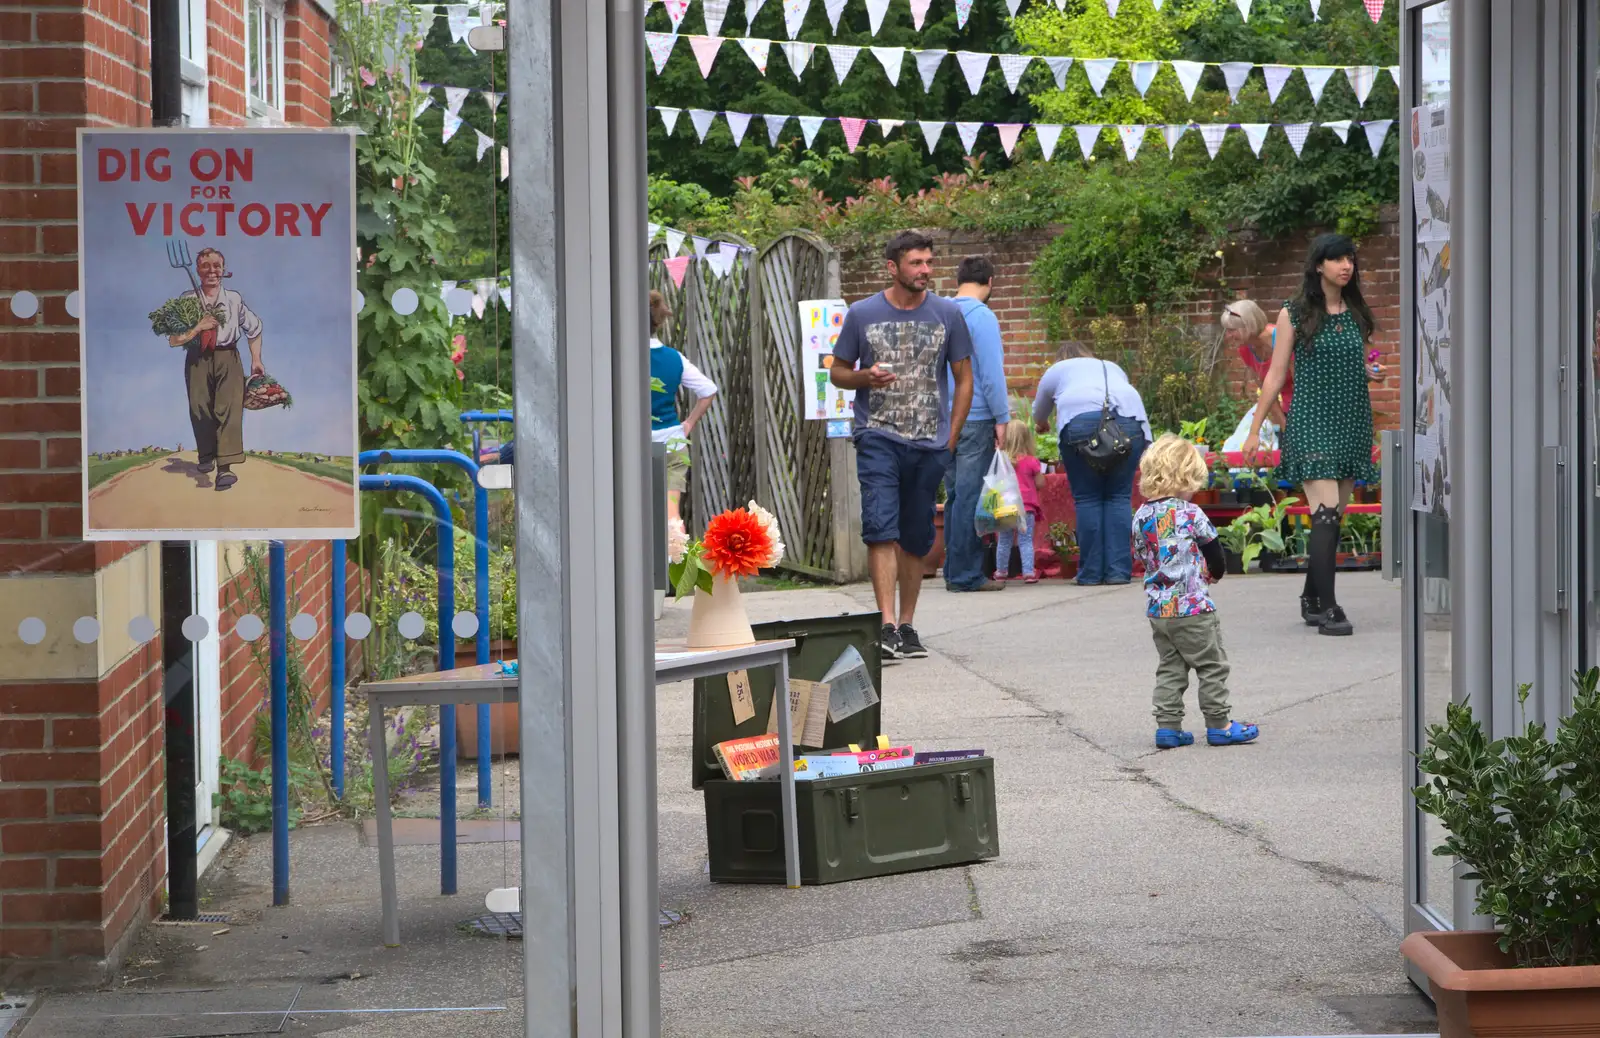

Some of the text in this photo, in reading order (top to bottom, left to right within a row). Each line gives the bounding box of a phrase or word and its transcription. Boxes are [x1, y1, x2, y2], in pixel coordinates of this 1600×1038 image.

[97, 148, 253, 182] DIG ON
[190, 185, 232, 199] FOR
[124, 202, 333, 237] VICTORY
[856, 670, 867, 690] RATION
[862, 690, 873, 706] BOOK
[725, 745, 736, 753] THE
[755, 738, 773, 749] HISTORY
[730, 749, 779, 767] WORLD WAR
